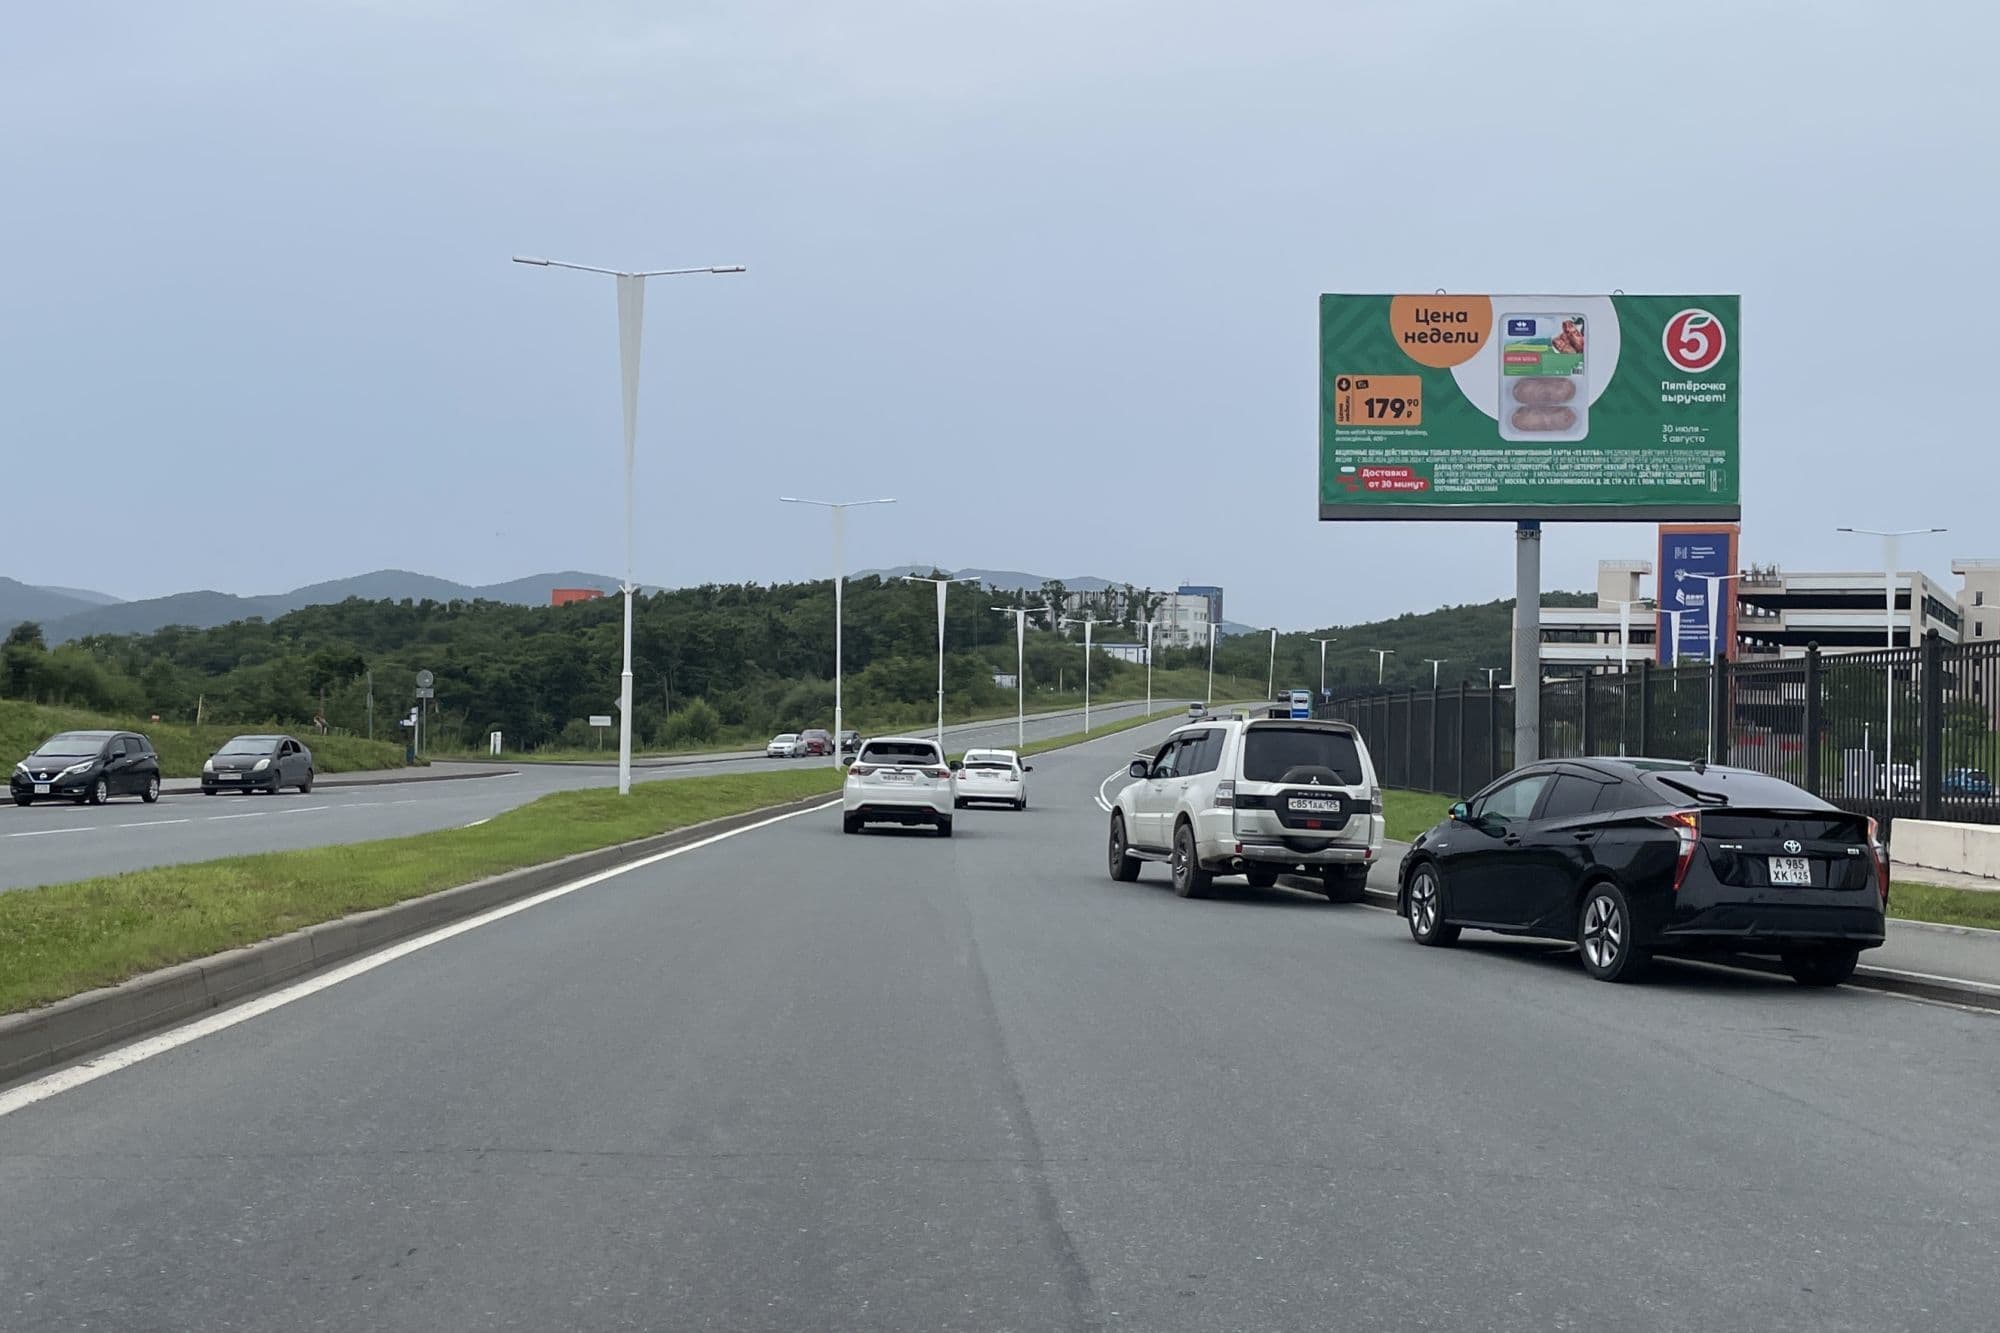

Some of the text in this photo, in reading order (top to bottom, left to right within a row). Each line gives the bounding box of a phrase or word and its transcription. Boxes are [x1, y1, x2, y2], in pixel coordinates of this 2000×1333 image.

[1416, 308, 1468, 326] Цена
[1404, 328, 1479, 343] недели
[1661, 380, 1727, 393] Пятёрочка
[1661, 393, 1726, 404] выручает!
[1365, 398, 1419, 418] 179 90
[1662, 424, 1673, 433] 30
[1675, 425, 1699, 433] июля
[1662, 435, 1705, 444] 5 августа
[1362, 469, 1408, 478] Доставка
[1381, 480, 1392, 488] 30
[1394, 481, 1425, 490] минут
[1776, 859, 1805, 869] А 985
[1773, 871, 1808, 881] ХК 125
